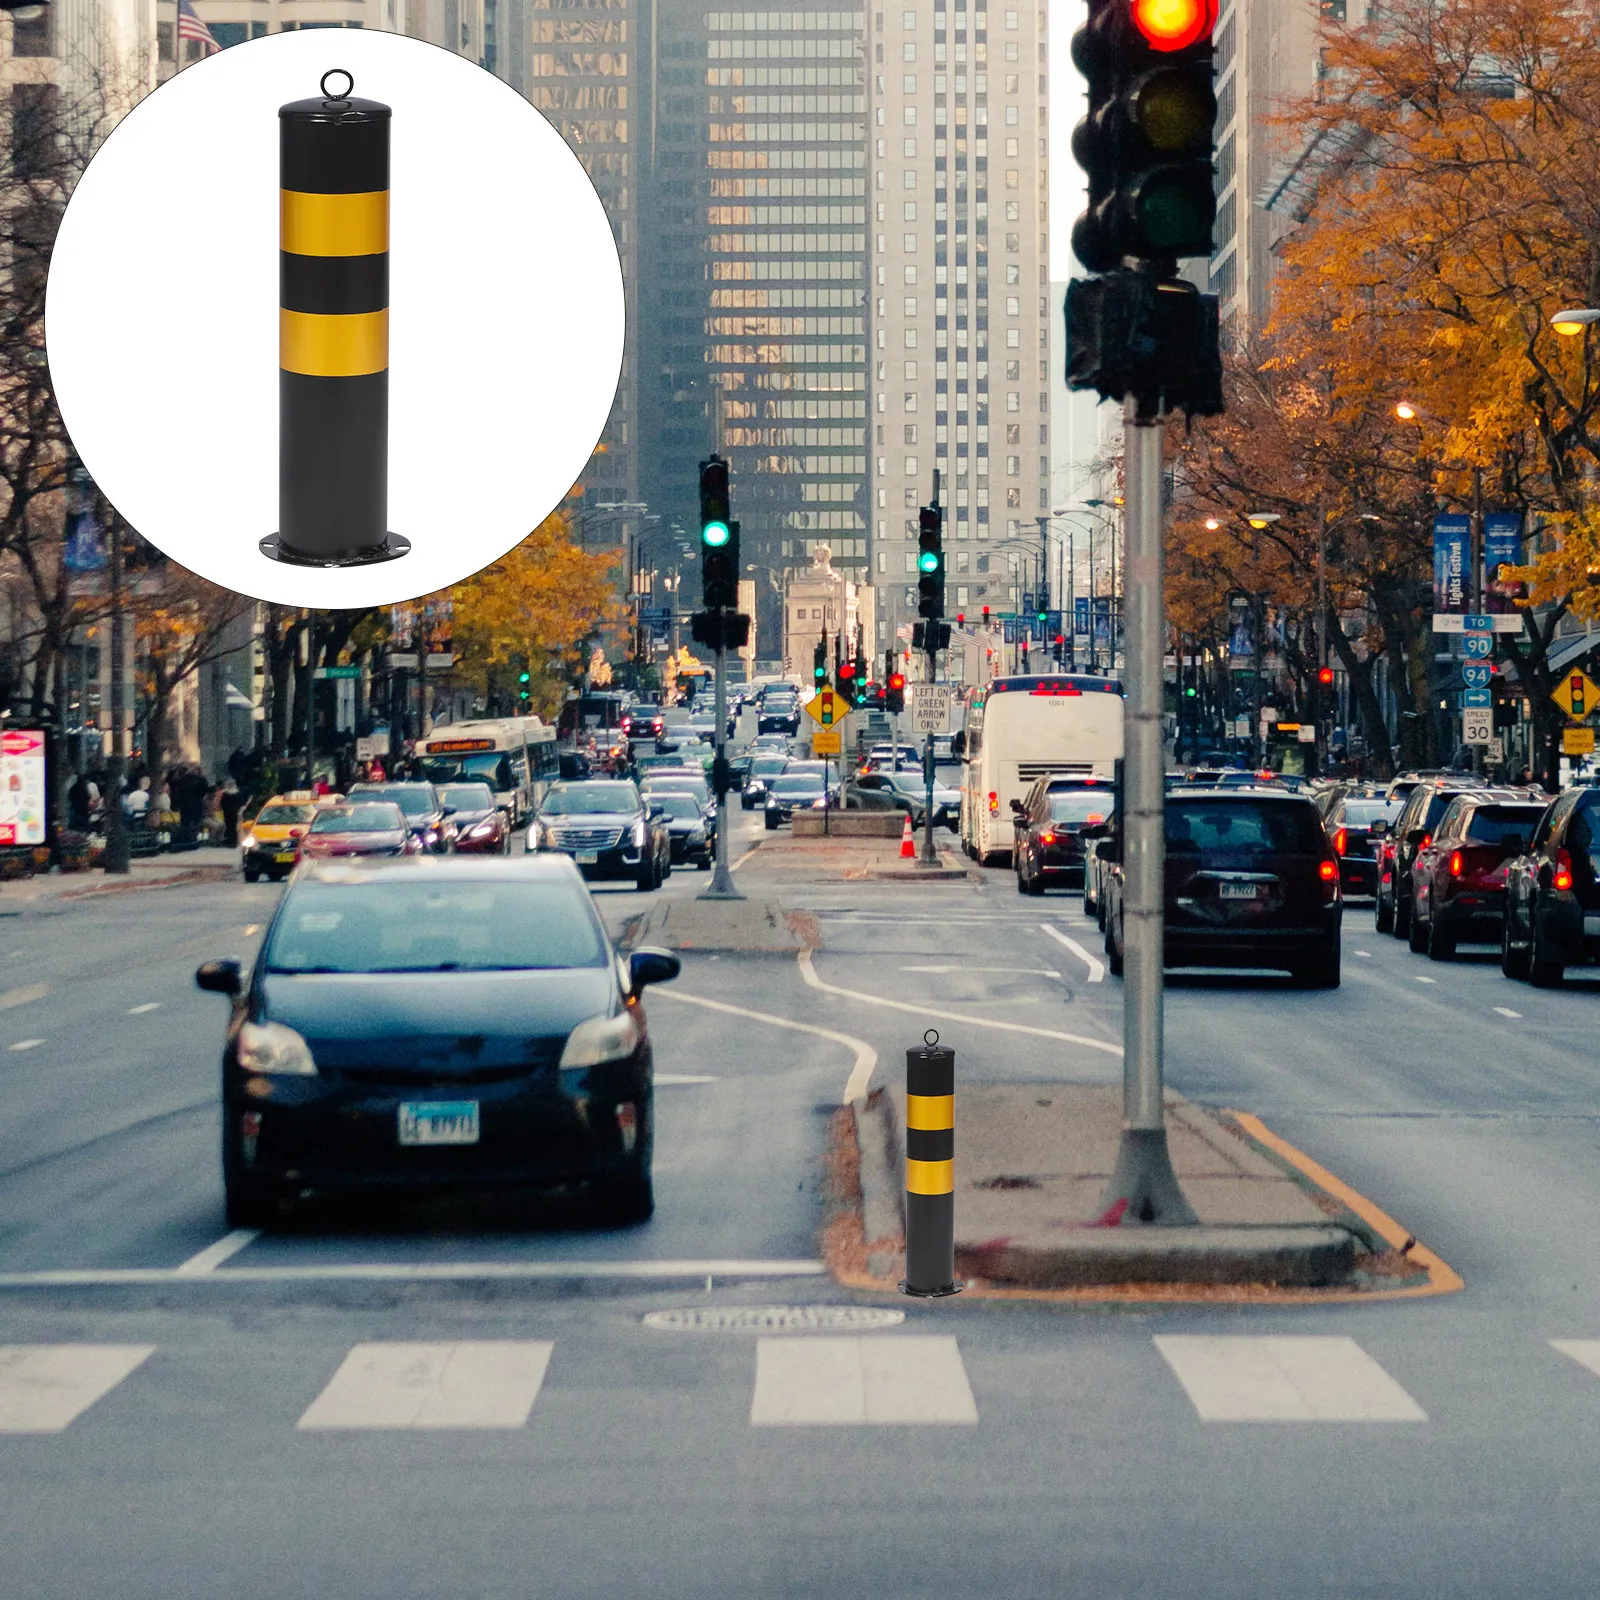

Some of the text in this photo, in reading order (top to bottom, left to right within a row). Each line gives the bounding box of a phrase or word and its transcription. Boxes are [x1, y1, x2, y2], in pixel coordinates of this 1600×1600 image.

[1449, 542, 1463, 605] Lights Festival
[1471, 618, 1485, 627] TO
[1468, 640, 1488, 654] 90
[1466, 669, 1487, 682] 94
[915, 687, 949, 697] LEFT ON
[919, 698, 945, 709] GREEN
[917, 709, 946, 719] ARROW
[920, 719, 941, 730] ONLY
[1467, 726, 1489, 740] 30
